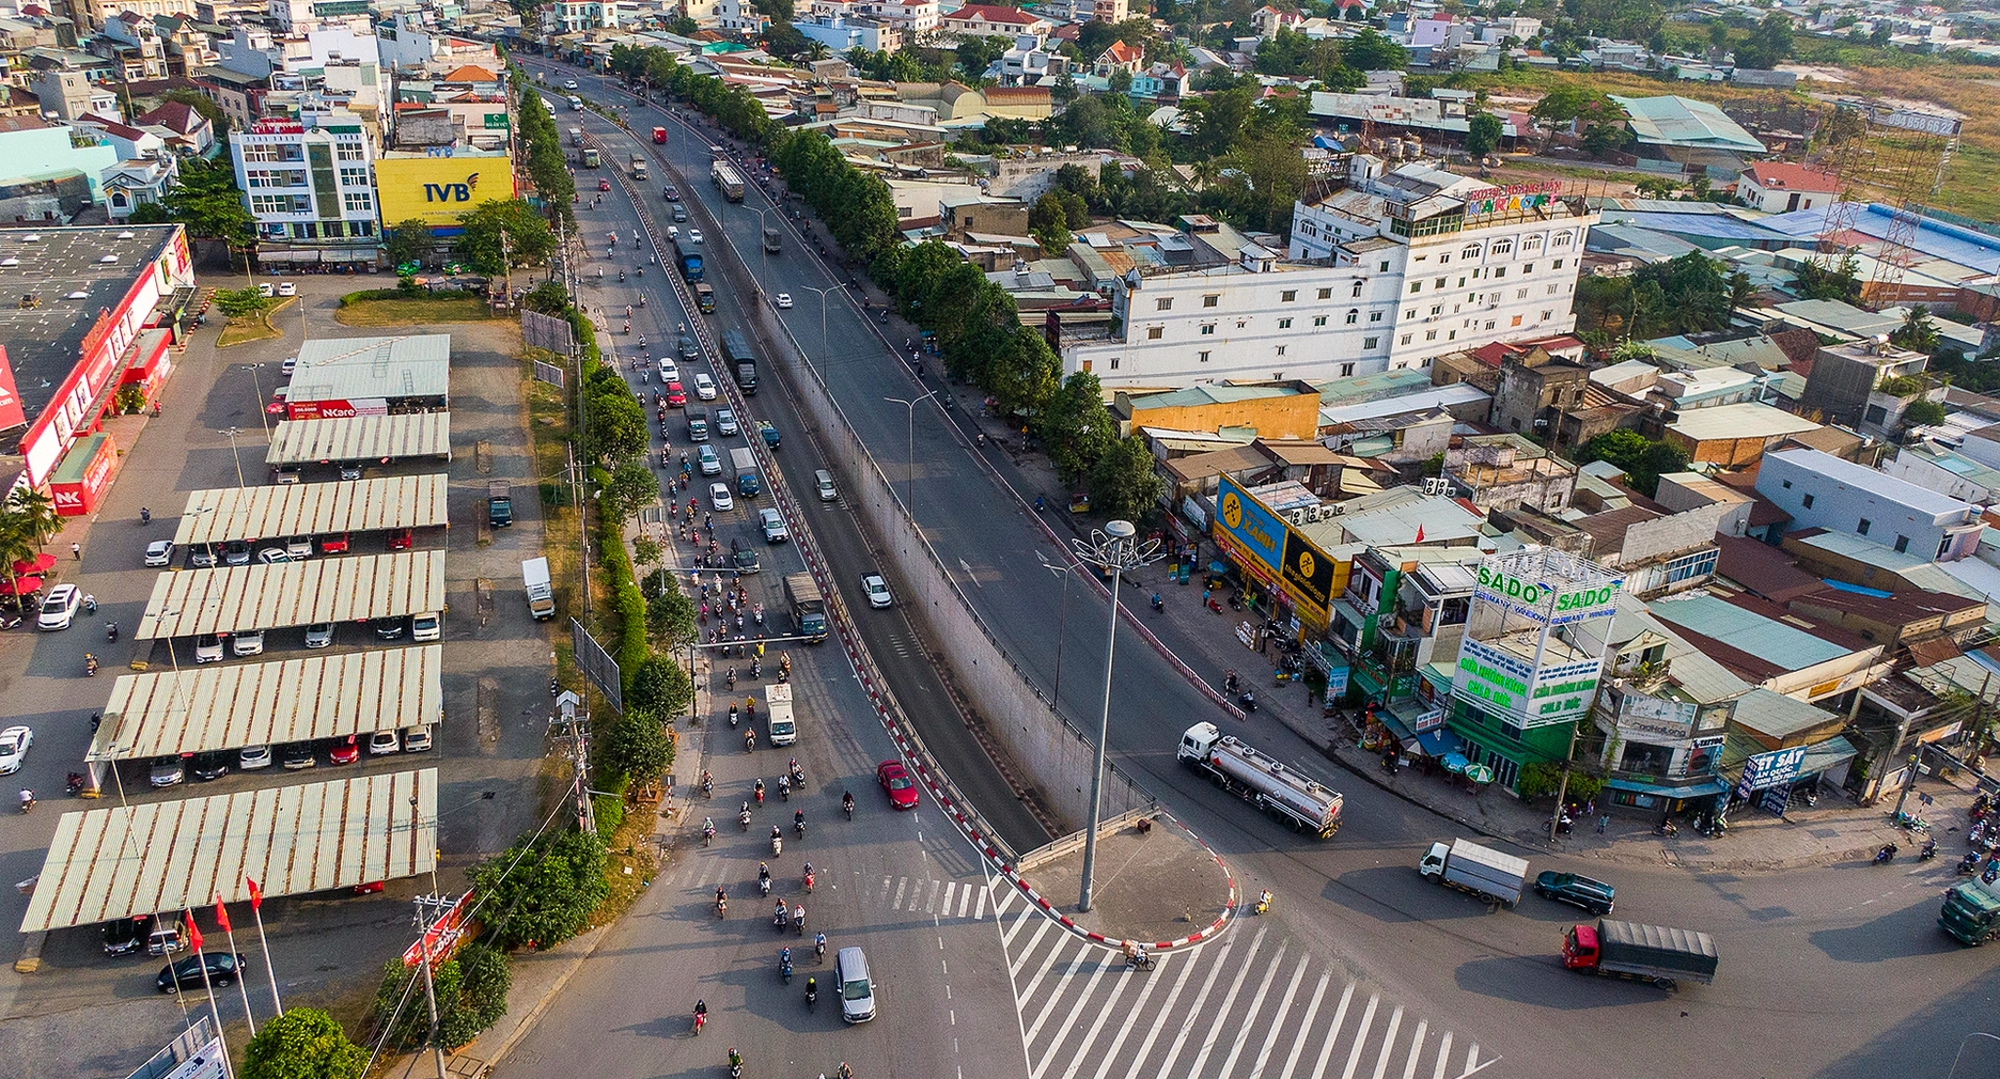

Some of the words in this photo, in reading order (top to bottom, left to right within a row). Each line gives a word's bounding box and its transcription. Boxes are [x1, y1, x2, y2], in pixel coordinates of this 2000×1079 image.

[1927, 119, 1939, 131] 66
[1468, 192, 1559, 216] KARAOKE
[55, 491, 81, 504] NK
[1242, 518, 1277, 553] XANH
[1477, 566, 1539, 605] SADO
[1555, 586, 1612, 611] SADO
[1700, 737, 1724, 747] TATTOO
[1775, 748, 1805, 767] SẮT
